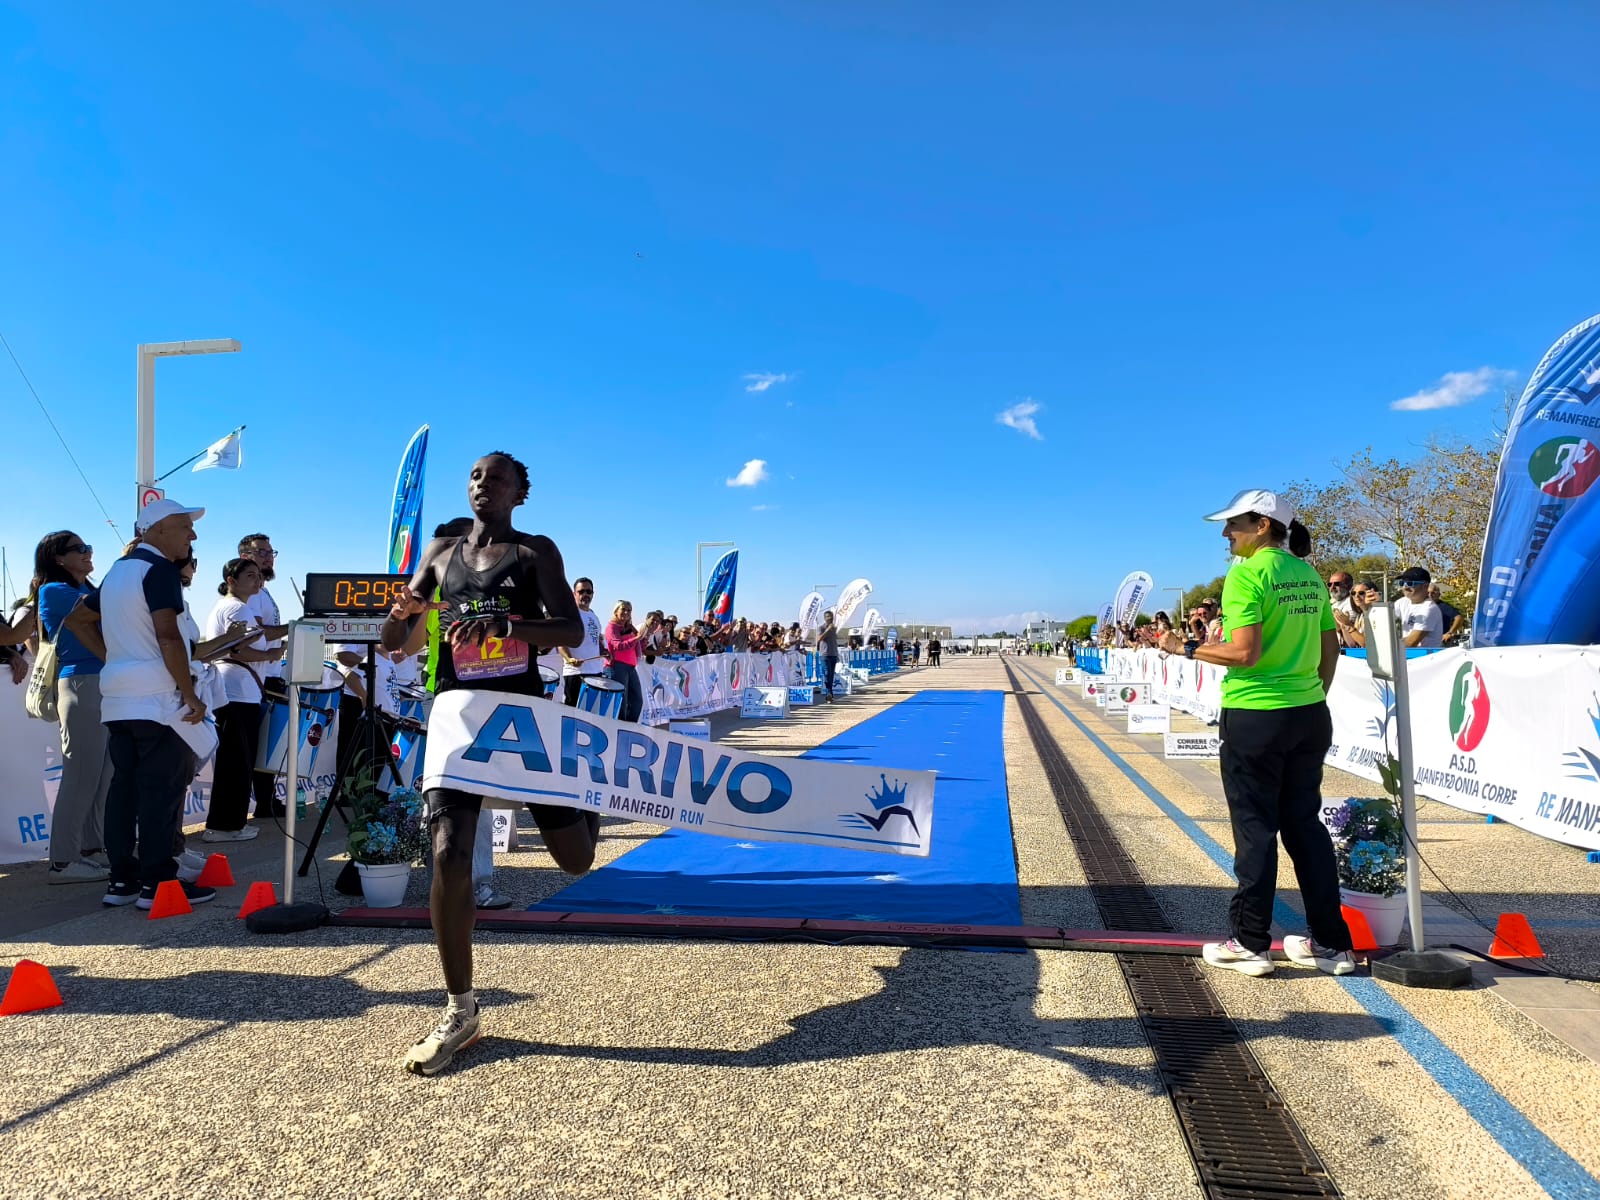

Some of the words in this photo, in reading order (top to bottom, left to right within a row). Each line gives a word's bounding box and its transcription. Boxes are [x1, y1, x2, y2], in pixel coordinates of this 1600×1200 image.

[461, 703, 793, 815] ARRIVO
[1449, 753, 1478, 775] A.S.D.
[1416, 766, 1479, 798] MANFREDONIA
[1481, 782, 1518, 806] CORRE
[584, 789, 603, 806] RE
[608, 794, 675, 820] MANFREDI
[679, 809, 705, 826] RUN
[1535, 791, 1557, 820] RE
[18, 813, 50, 844] RE
